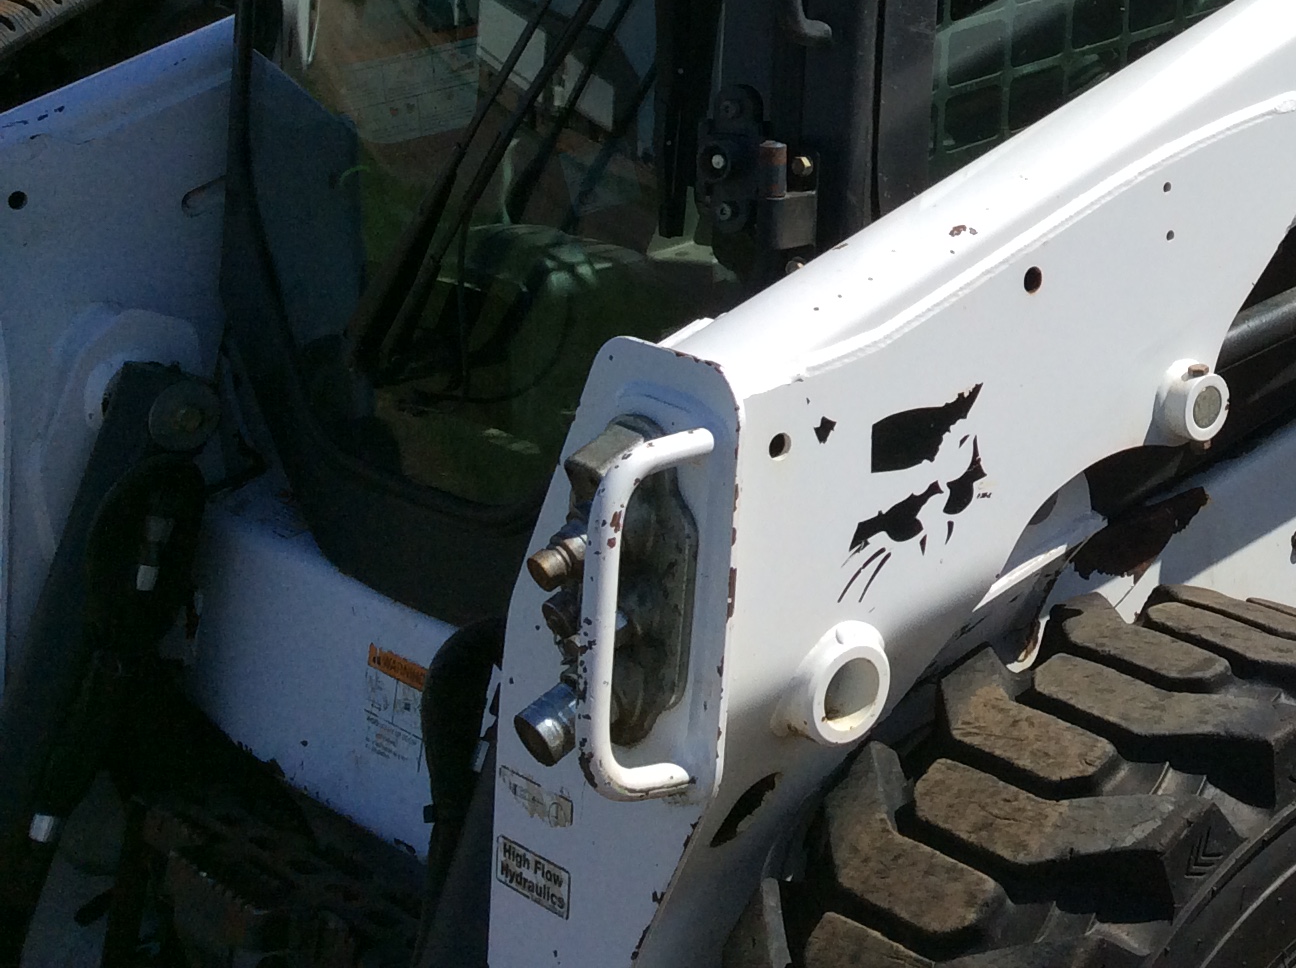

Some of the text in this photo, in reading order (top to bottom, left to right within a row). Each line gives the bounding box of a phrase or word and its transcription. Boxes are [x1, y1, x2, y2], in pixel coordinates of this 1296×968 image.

[499, 861, 566, 910] Hydraulics
[502, 841, 564, 889] High Flow
